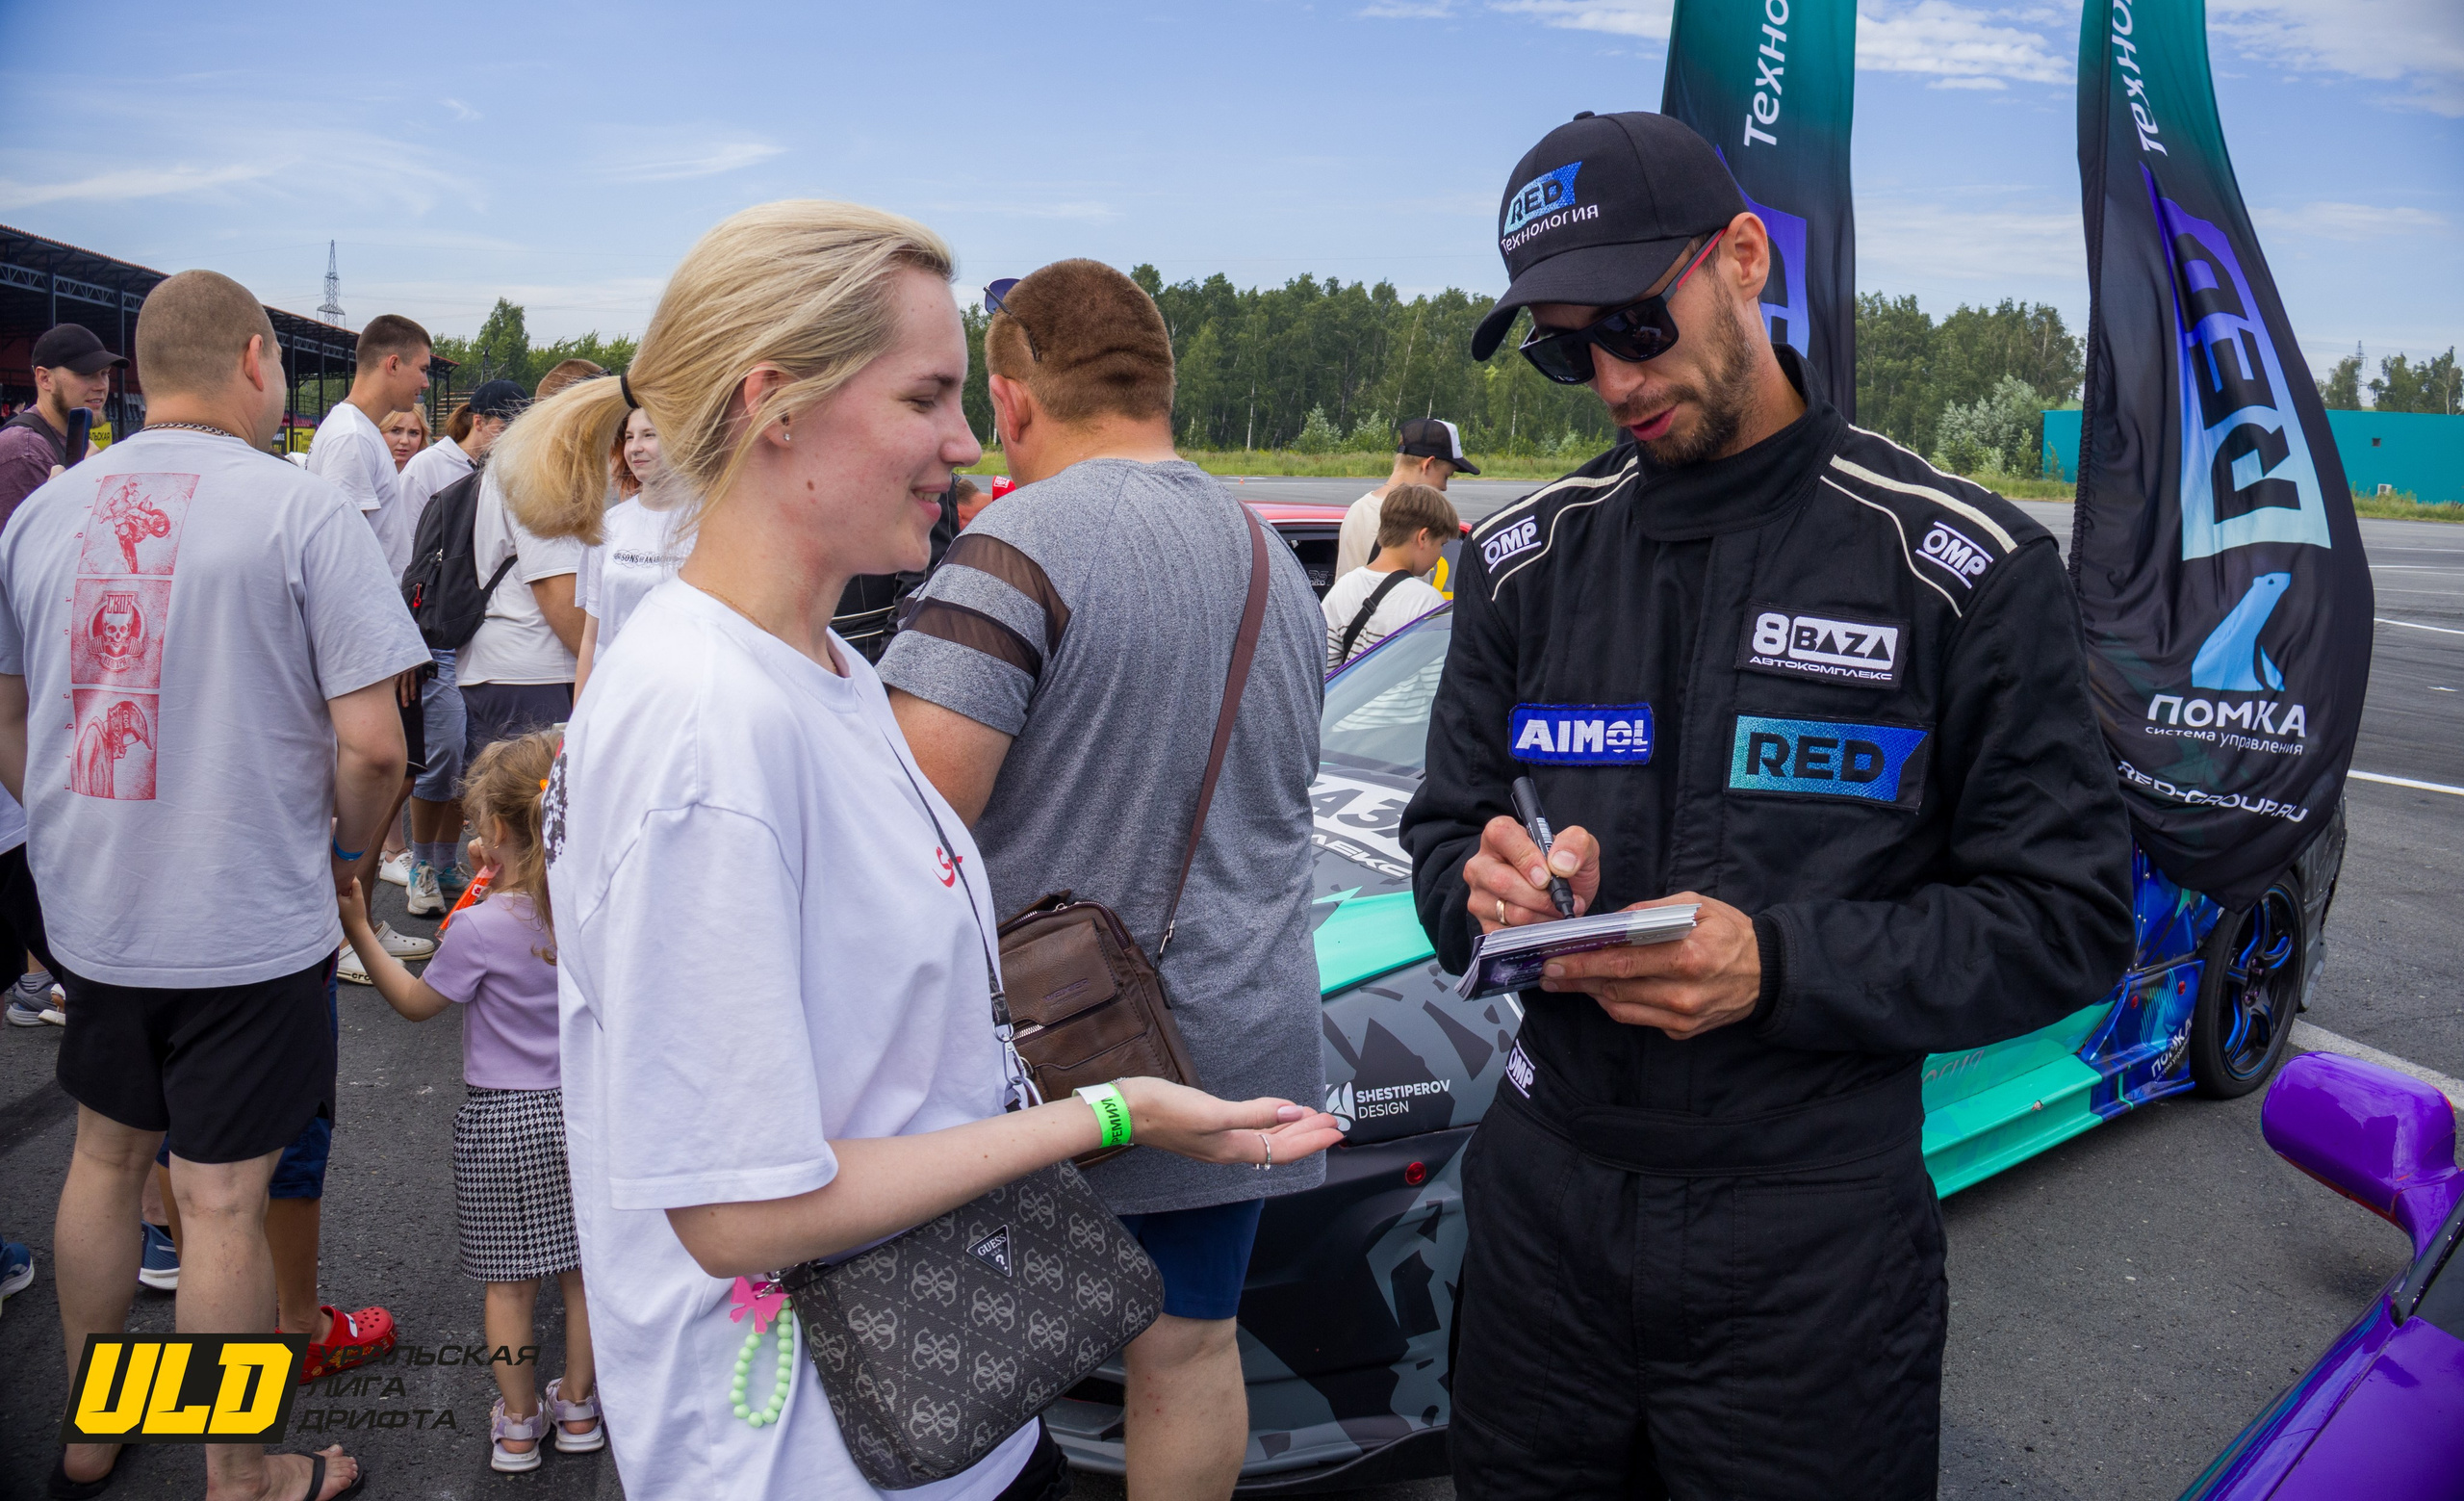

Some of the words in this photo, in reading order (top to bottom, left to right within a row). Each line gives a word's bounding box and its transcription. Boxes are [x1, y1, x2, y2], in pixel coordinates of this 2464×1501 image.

[2112, 0, 2168, 157] Техно
[1510, 179, 1563, 225] RED
[1502, 204, 1599, 255] Технология
[2173, 233, 2302, 526] RED
[90, 432, 111, 441] АЛЬСКАЯ
[621, 554, 639, 563] SONS
[1484, 522, 1537, 565] OMP
[1923, 529, 1987, 576] OMP
[1749, 656, 1892, 681] АВТОКОМПЛЕКС
[1515, 719, 1648, 753] AIMOL
[2147, 694, 2306, 738] ПОМКА
[1746, 732, 1886, 784] RED
[2145, 726, 2216, 741] система
[2220, 733, 2304, 755] управления
[351, 972, 372, 981] cro
[1508, 1047, 1534, 1089] OMP
[1355, 1079, 1450, 1103] SHESTIPEROV
[1358, 1100, 1409, 1120] DESIGN
[1101, 1098, 1122, 1146] РЕМИУ
[977, 1233, 1007, 1256] GUESS
